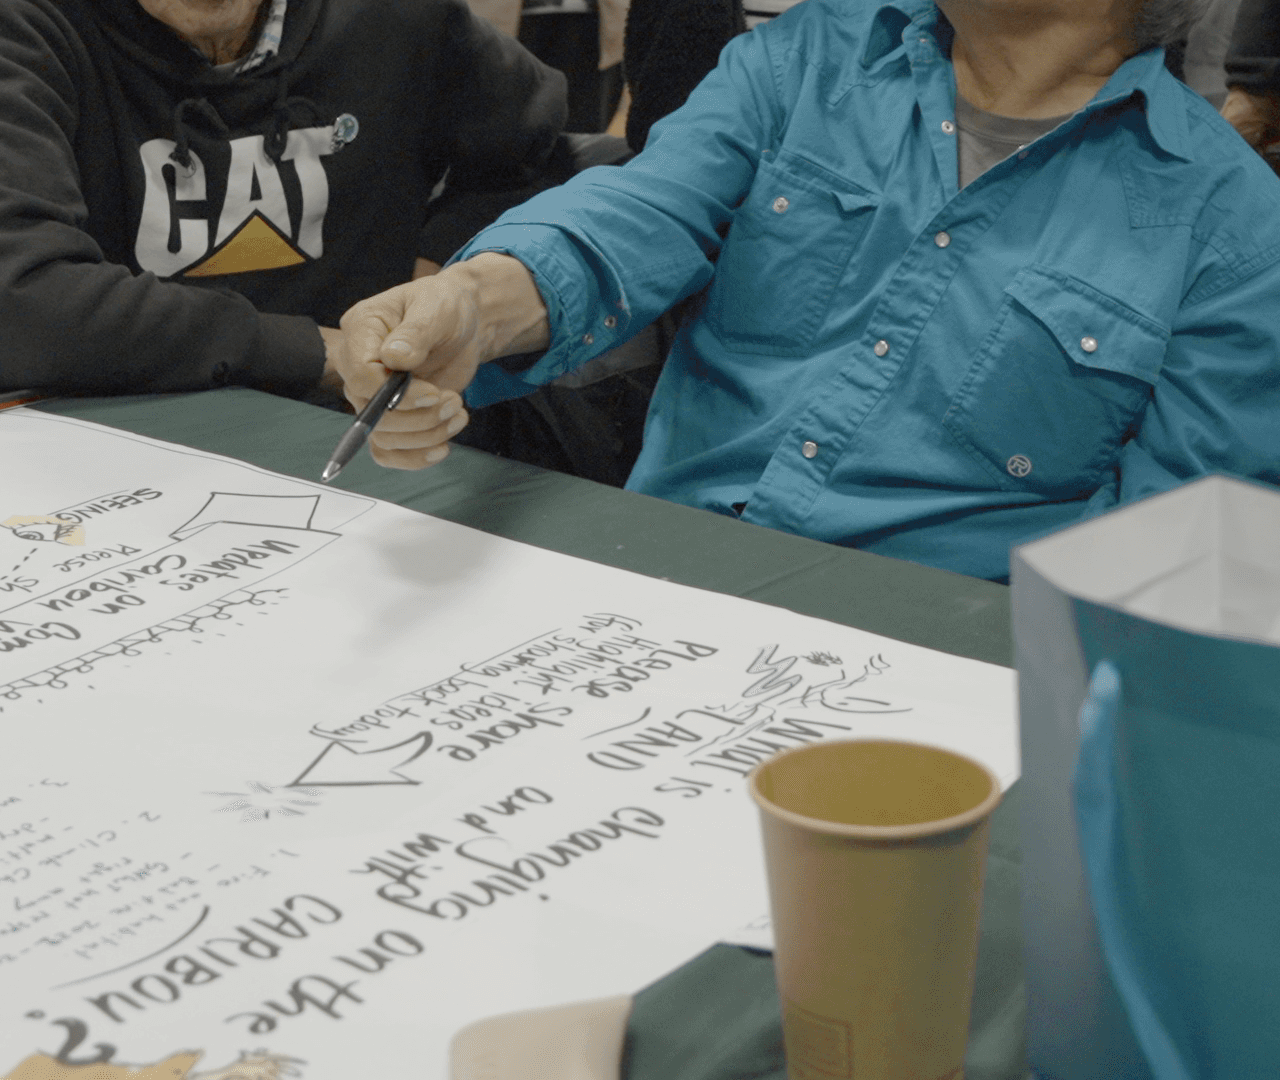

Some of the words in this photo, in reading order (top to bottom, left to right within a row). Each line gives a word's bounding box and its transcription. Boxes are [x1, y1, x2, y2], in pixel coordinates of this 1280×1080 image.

[135, 126, 335, 278] CAT
[55, 488, 163, 526] SEEING
[53, 544, 142, 572] Please
[159, 540, 300, 591] Updates
[91, 591, 145, 614] on
[460, 635, 577, 678] sharing
[513, 635, 661, 695] Highlight
[402, 677, 488, 708] back
[429, 691, 532, 731] ideas
[437, 704, 573, 762] share
[586, 709, 745, 771] LAND
[653, 777, 731, 798] is
[458, 787, 553, 834] and
[335, 930, 425, 974] on
[226, 975, 364, 1035] the
